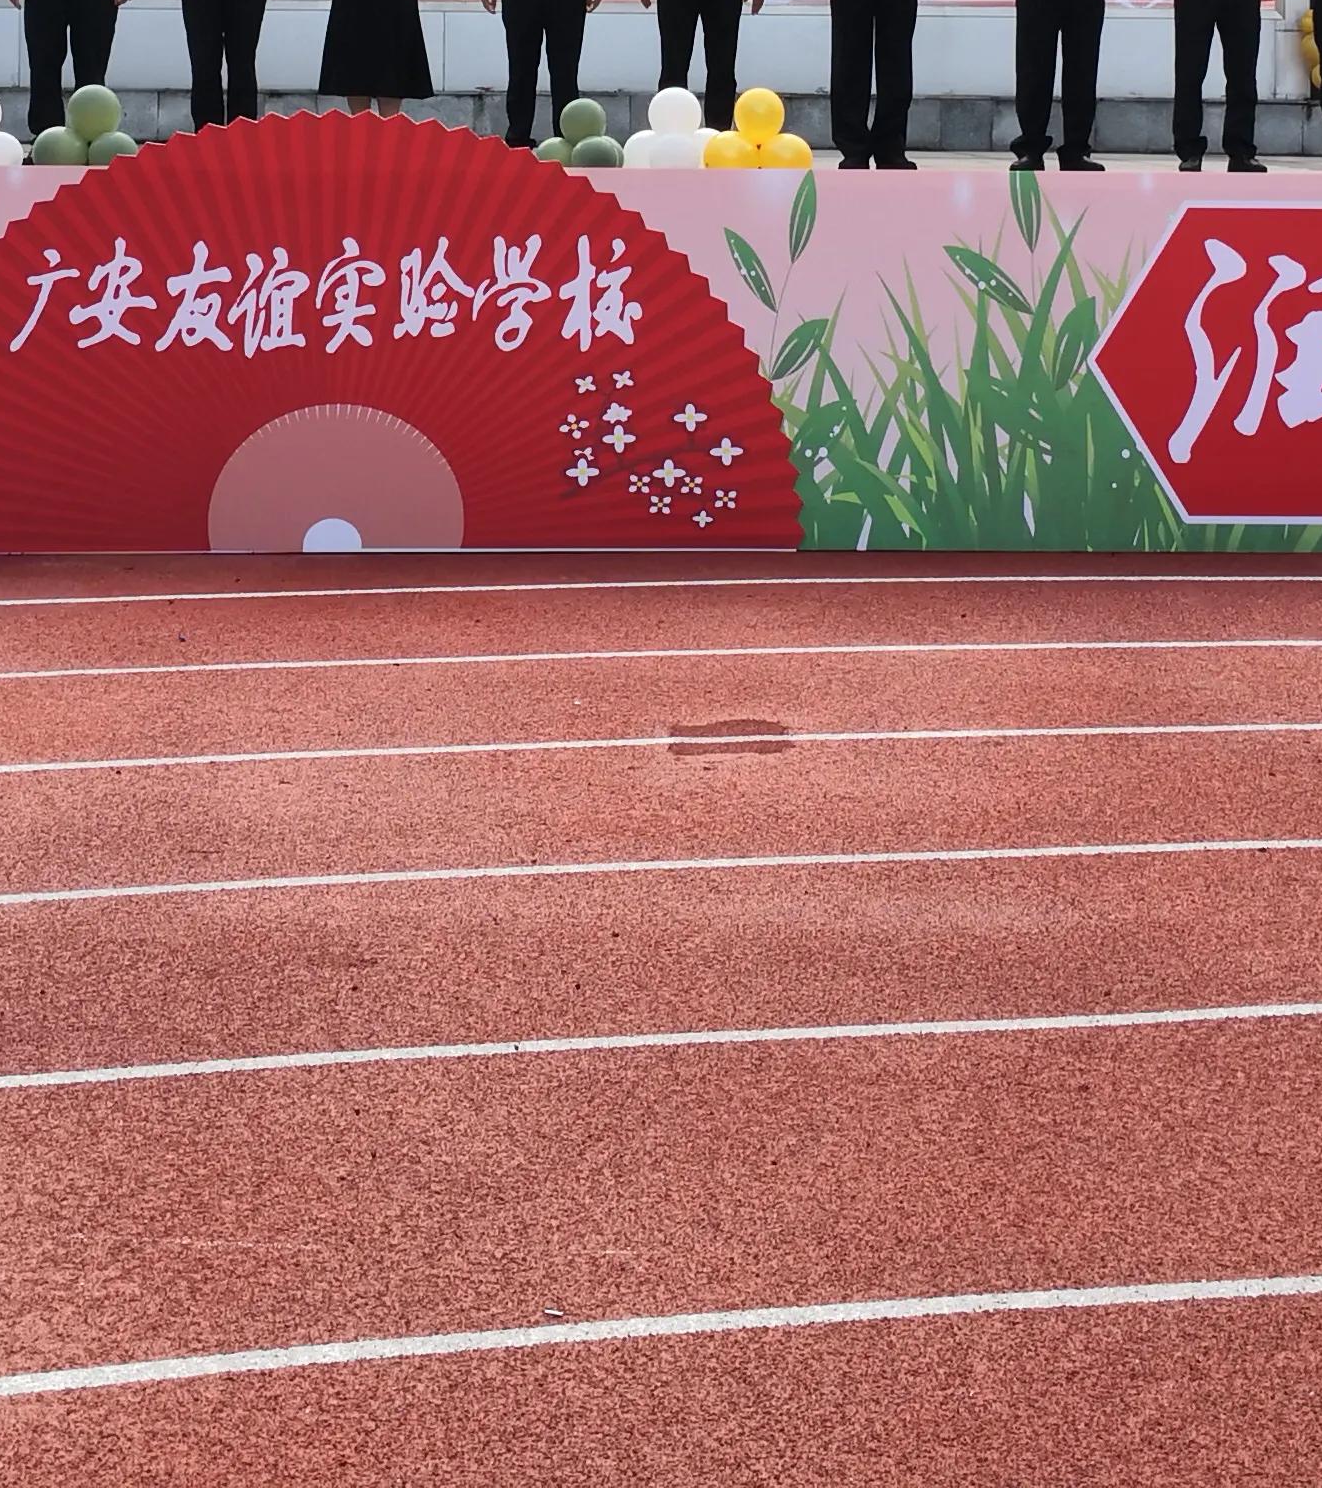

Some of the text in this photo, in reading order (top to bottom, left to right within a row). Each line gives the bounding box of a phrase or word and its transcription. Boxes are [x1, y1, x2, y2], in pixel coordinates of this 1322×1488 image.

[9, 234, 643, 359] 广安友谊实验学校
